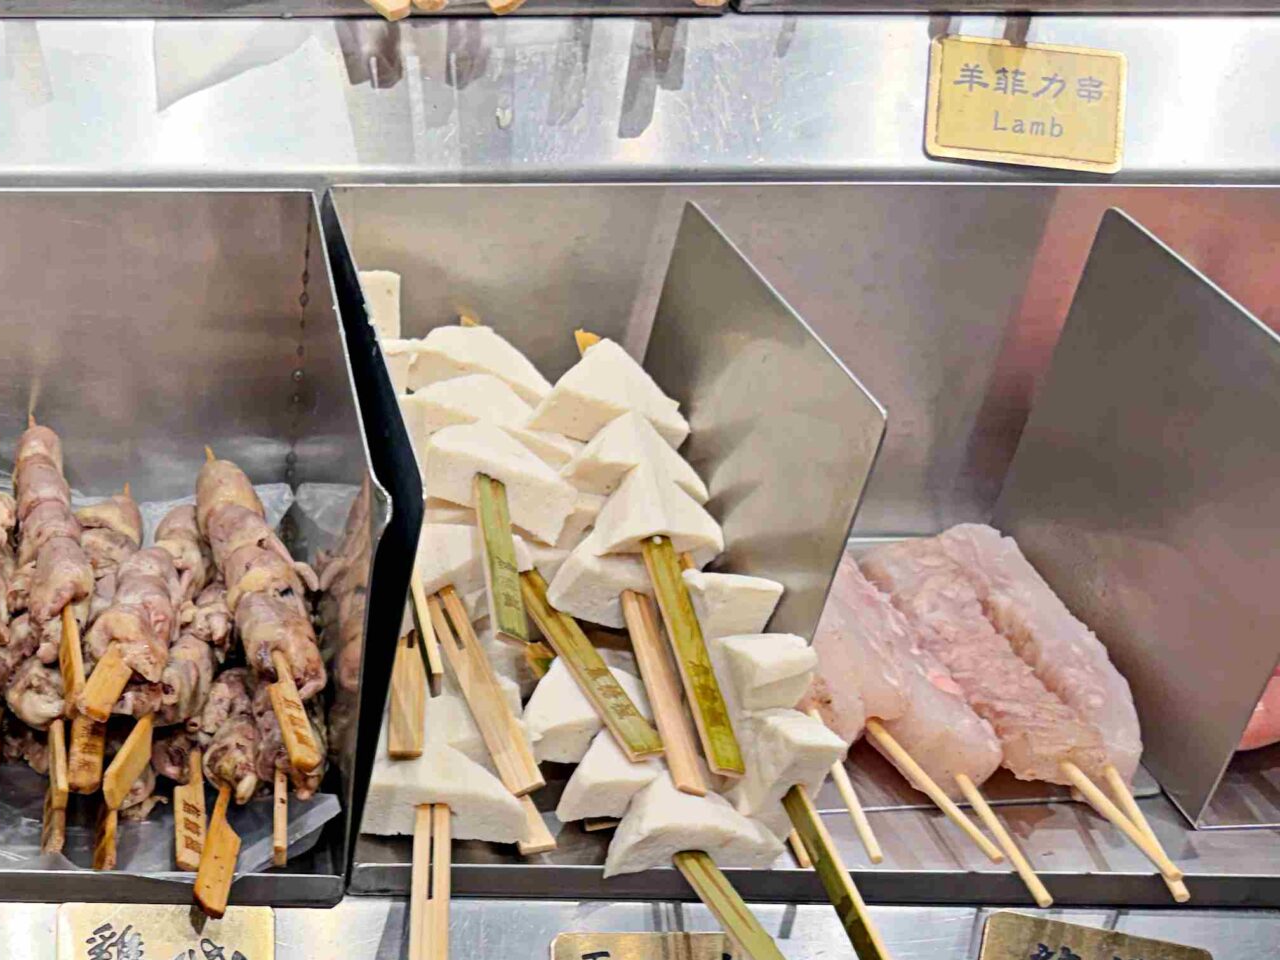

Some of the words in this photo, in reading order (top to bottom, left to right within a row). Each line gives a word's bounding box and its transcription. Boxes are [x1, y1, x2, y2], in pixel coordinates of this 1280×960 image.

[953, 63, 1105, 104] 羊菲力串
[993, 111, 1064, 138] Lamb
